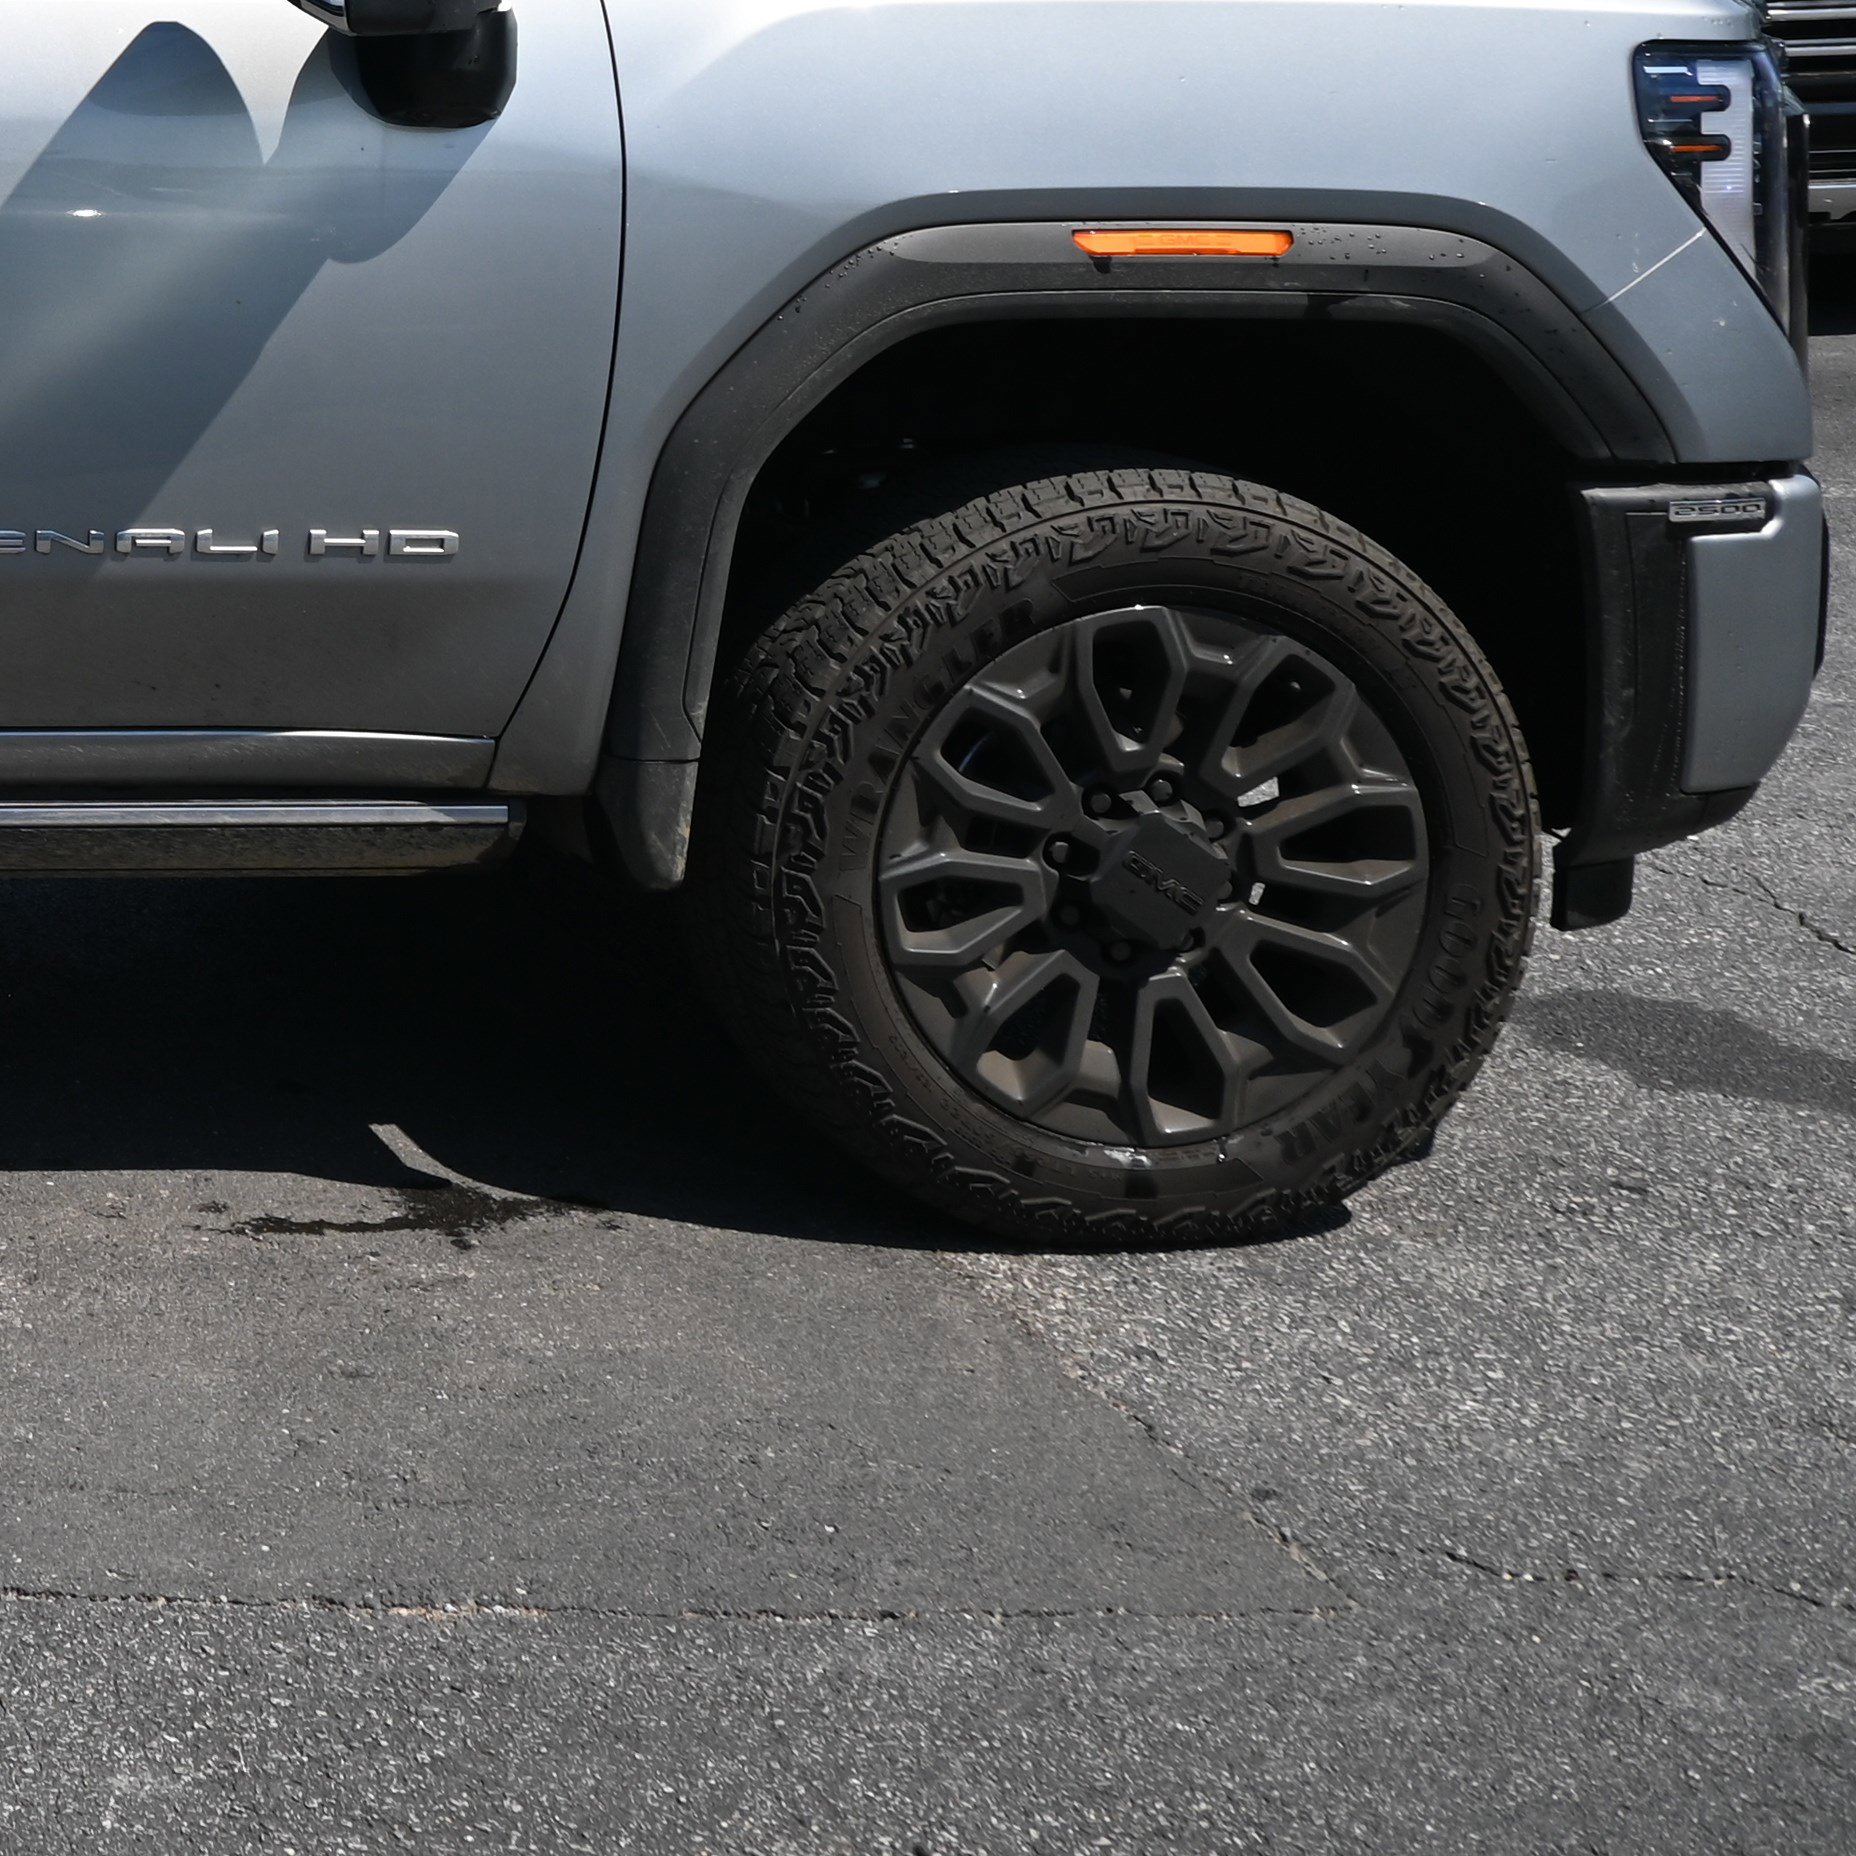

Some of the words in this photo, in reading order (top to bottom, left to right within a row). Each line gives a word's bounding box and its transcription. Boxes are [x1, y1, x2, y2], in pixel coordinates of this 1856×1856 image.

[308, 528, 460, 557] HD
[841, 596, 1038, 870] WRANGLER
[1124, 849, 1205, 916] GMC
